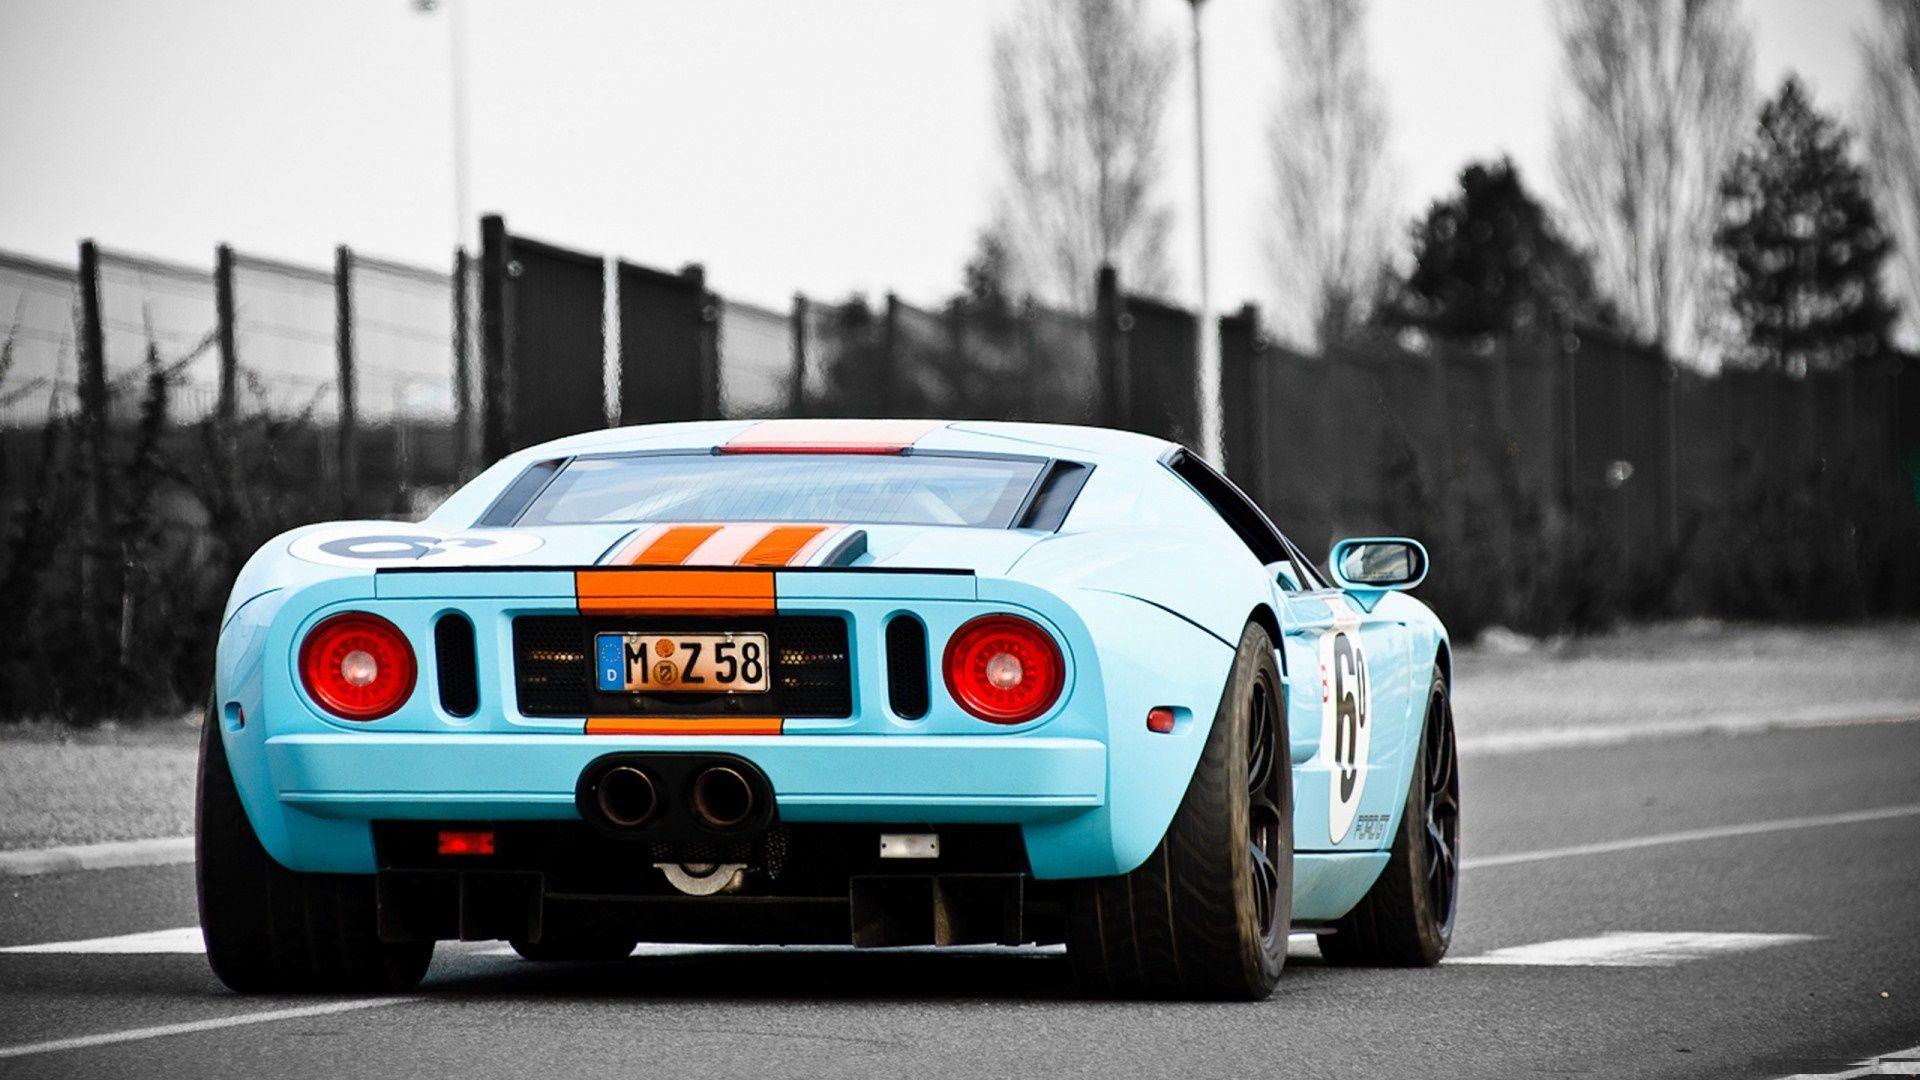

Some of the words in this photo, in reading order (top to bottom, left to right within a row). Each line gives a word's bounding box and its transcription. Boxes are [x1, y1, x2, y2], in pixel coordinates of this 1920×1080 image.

[606, 668, 617, 681] D
[624, 642, 648, 684] M
[680, 643, 704, 684] Z
[715, 642, 762, 684] 58
